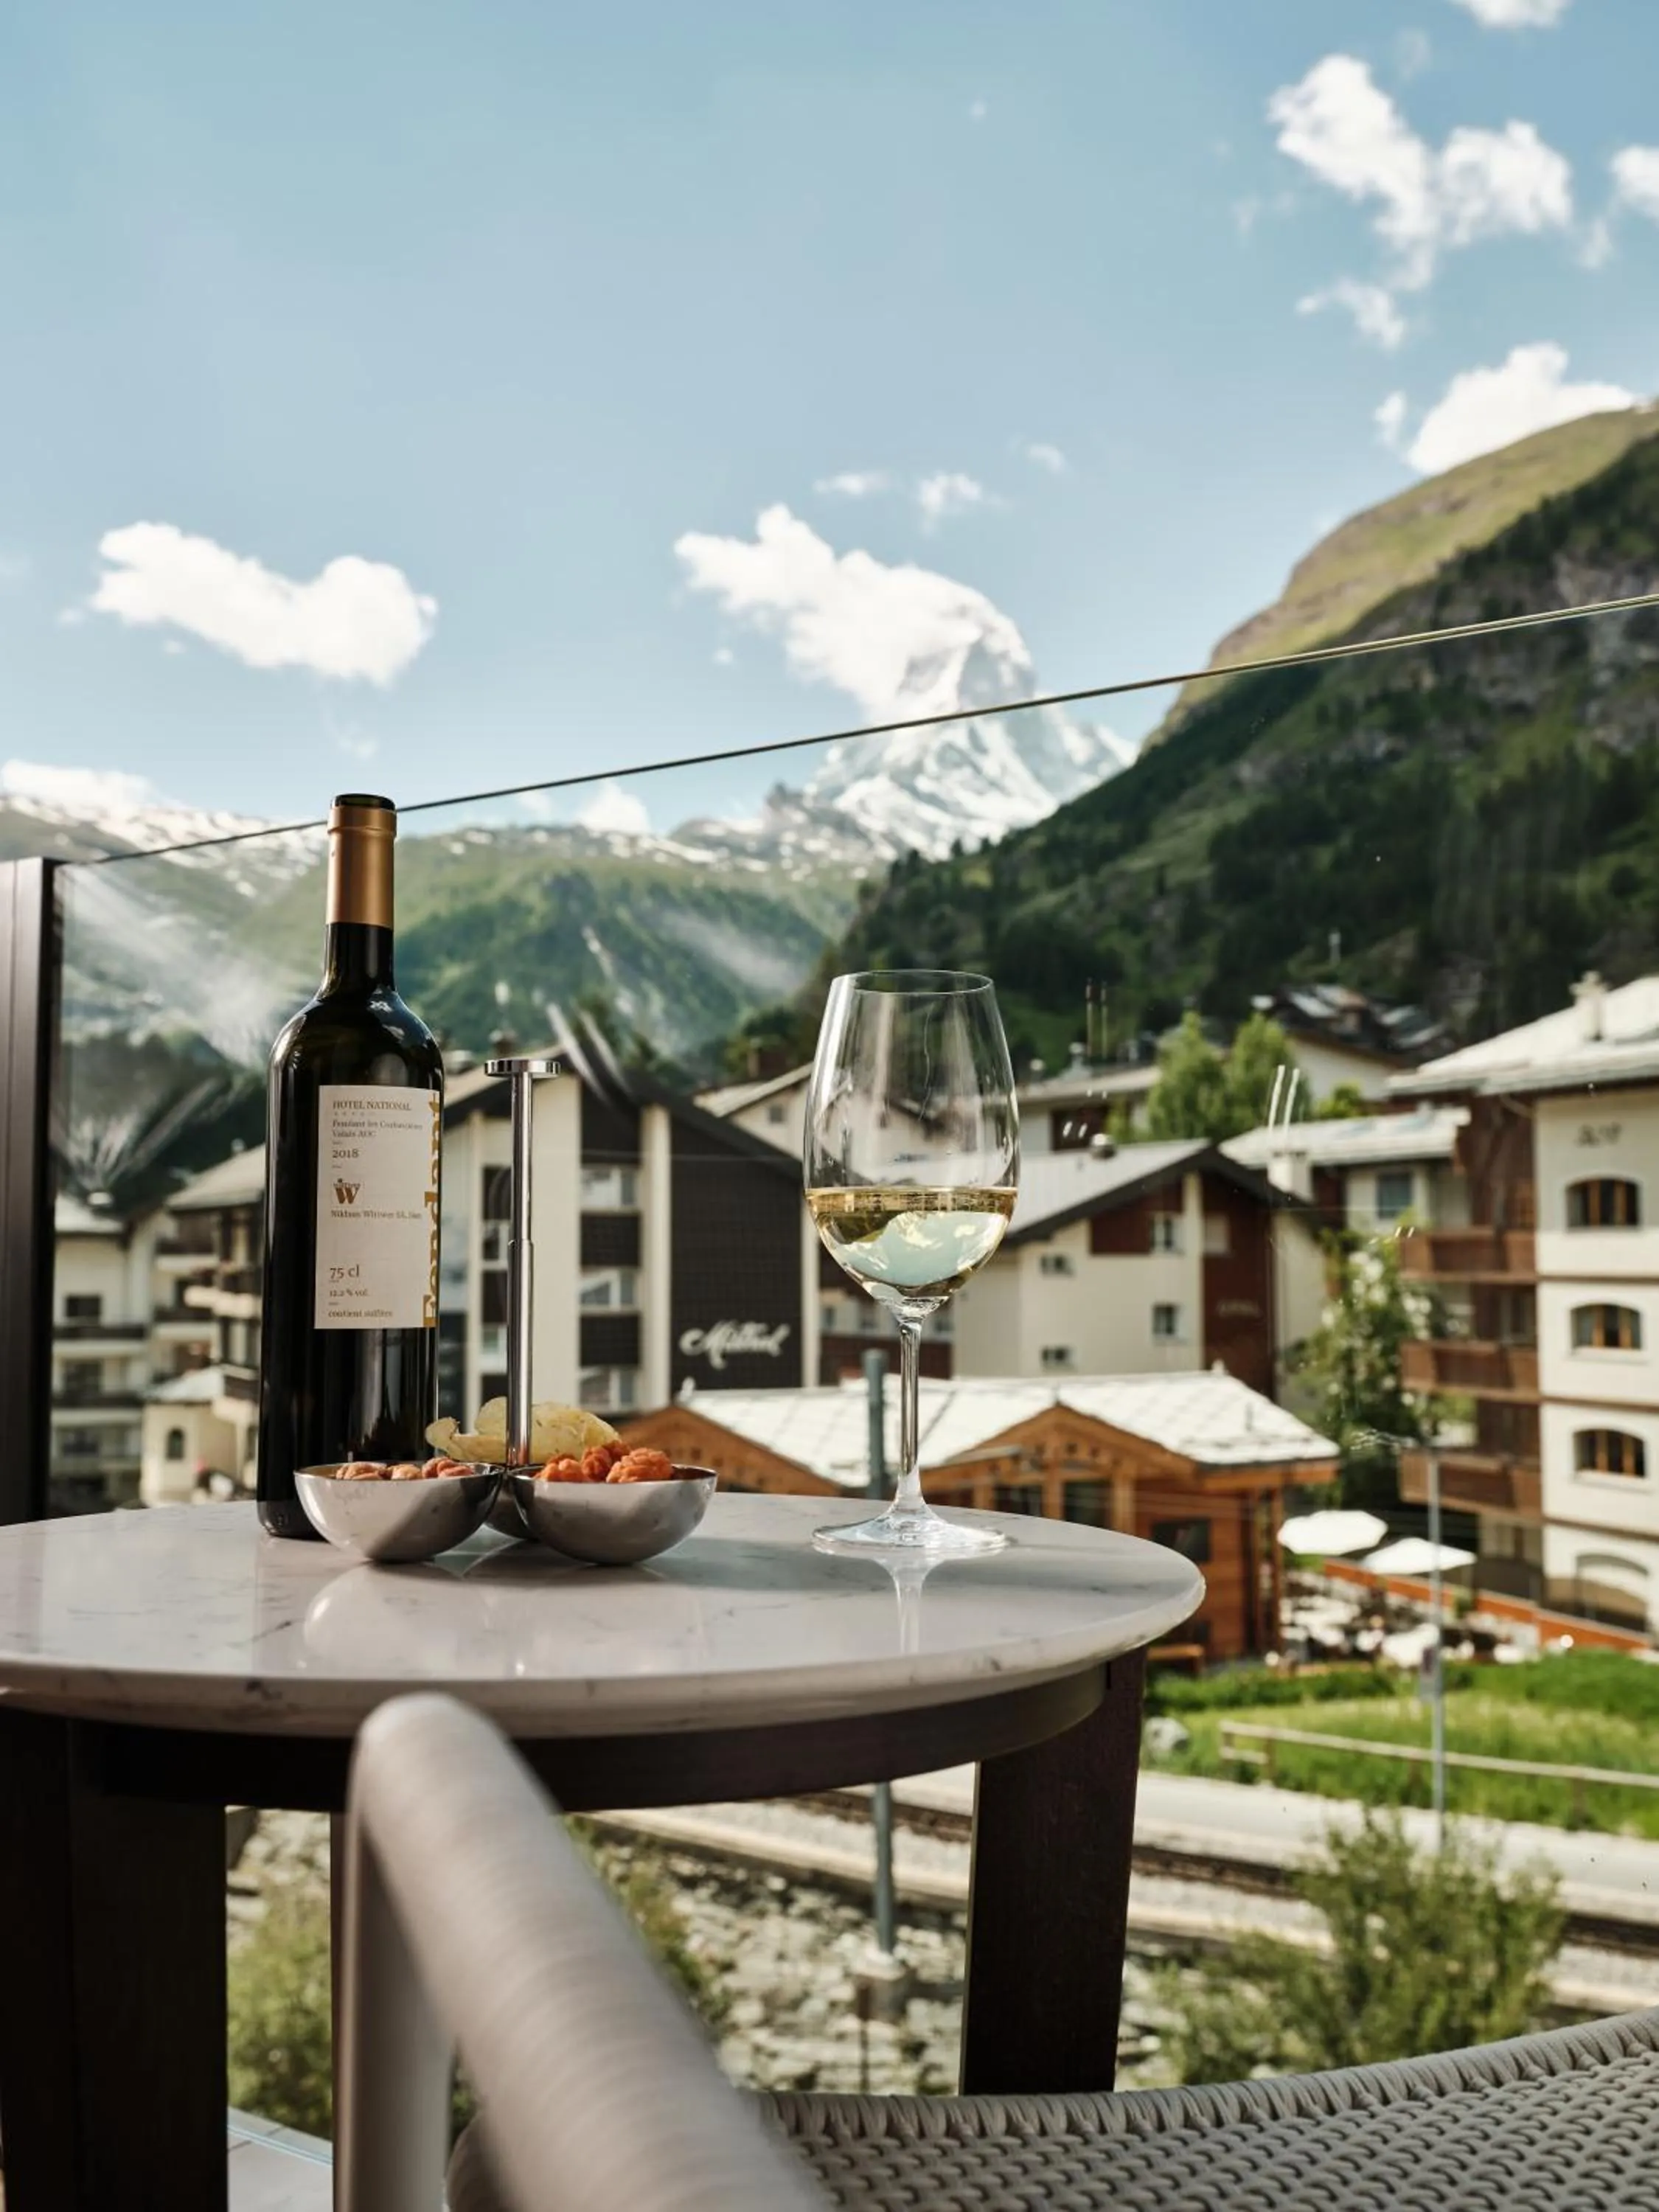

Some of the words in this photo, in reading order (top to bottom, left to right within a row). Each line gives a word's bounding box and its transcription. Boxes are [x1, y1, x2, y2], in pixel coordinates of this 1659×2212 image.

[333, 1100, 366, 1110] HOTEL
[368, 1101, 411, 1111] NATIONAL
[332, 1149, 359, 1158] 2018
[330, 1267, 344, 1279] 75
[347, 1264, 360, 1278] cl
